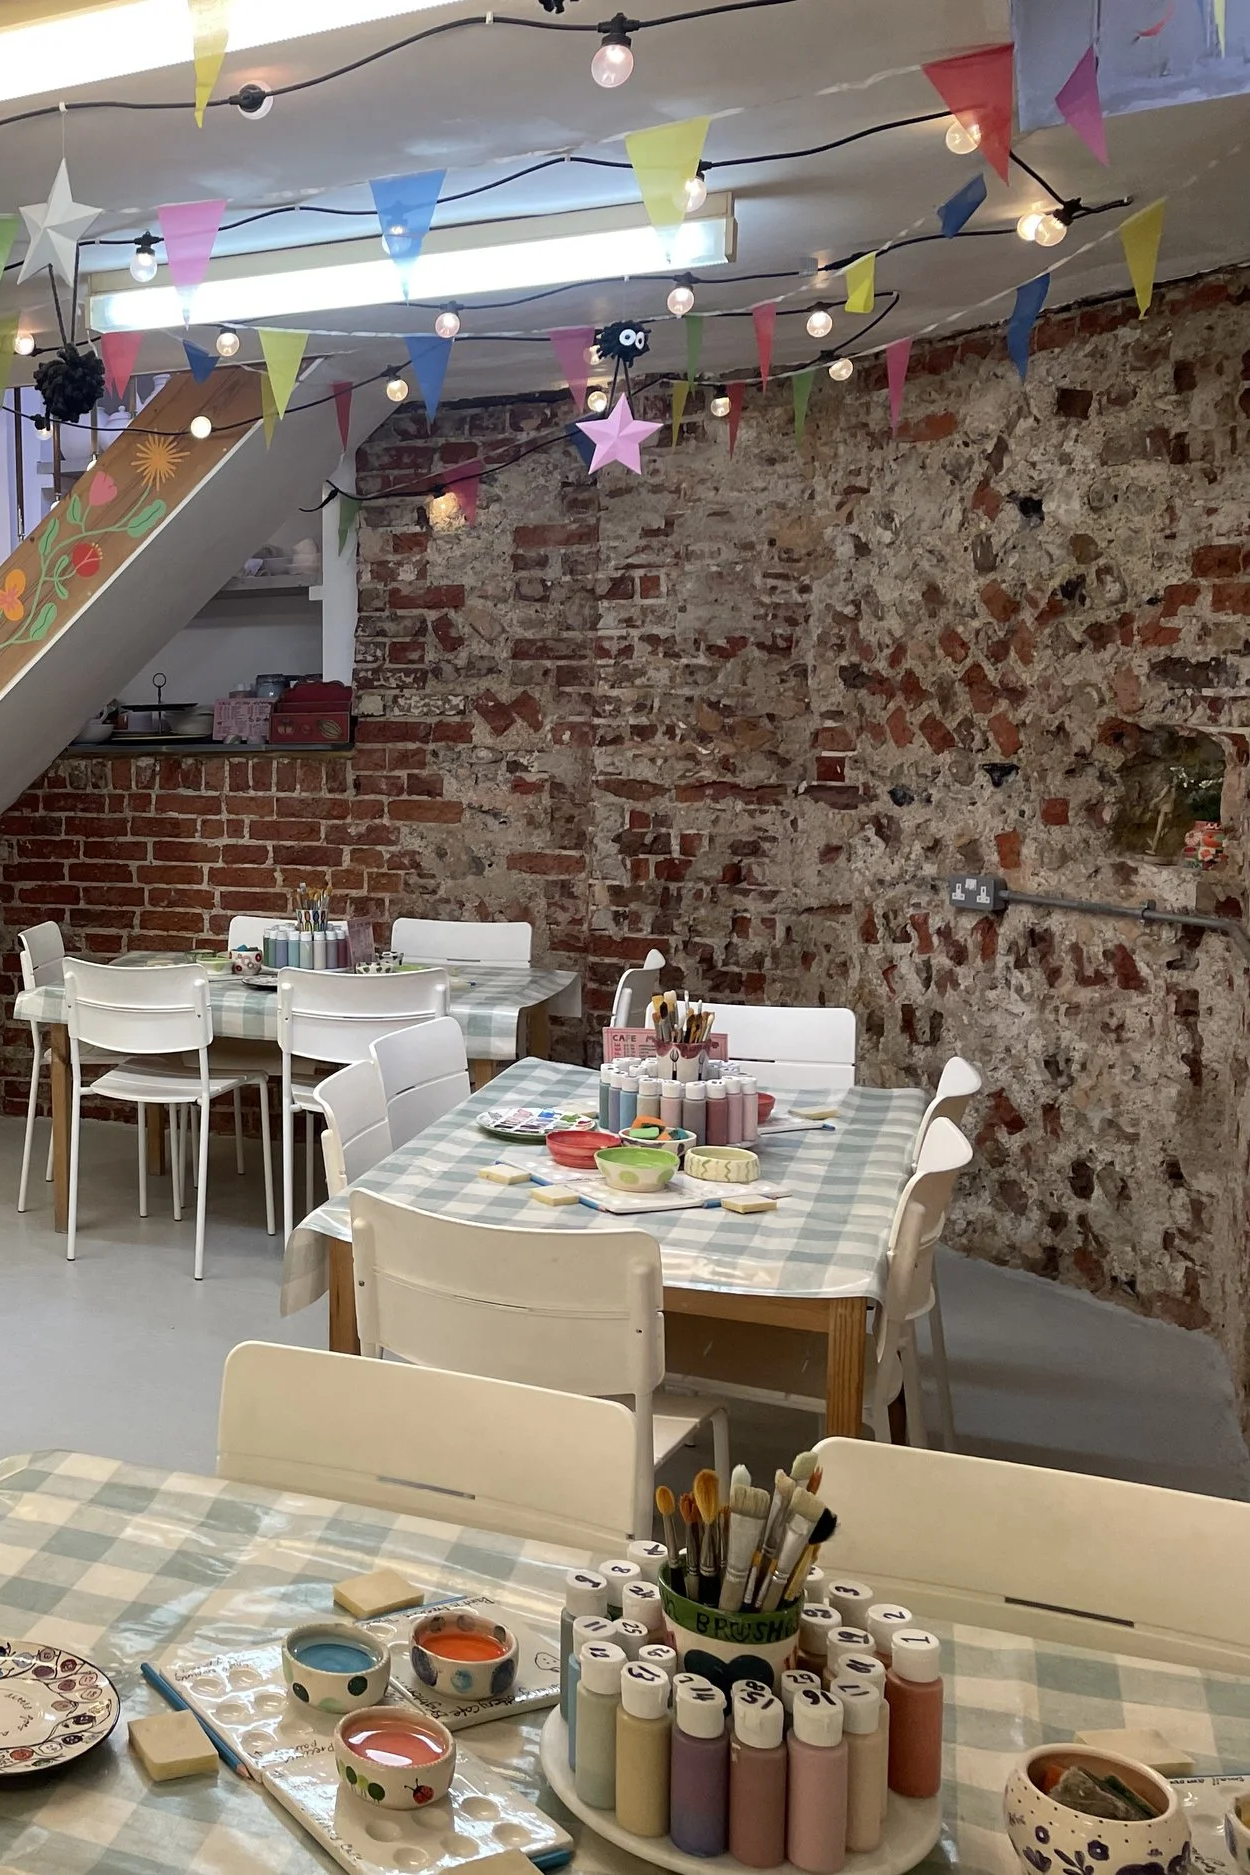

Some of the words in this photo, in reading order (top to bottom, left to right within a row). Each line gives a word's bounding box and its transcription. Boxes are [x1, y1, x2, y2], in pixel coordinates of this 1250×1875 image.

[612, 1034, 637, 1043] CAFE
[611, 1565, 631, 1574] 8
[629, 1585, 657, 1599] 24
[834, 1585, 860, 1596] 3
[882, 1611, 906, 1620] 2
[583, 1620, 608, 1632] 11
[621, 1622, 643, 1635] 25
[837, 1630, 870, 1645] 19
[900, 1635, 931, 1645] 1
[588, 1647, 610, 1659] 12
[627, 1665, 661, 1682] 13
[786, 1673, 815, 1684] 29
[837, 1684, 870, 1697] 17
[802, 1689, 837, 1706] 16
